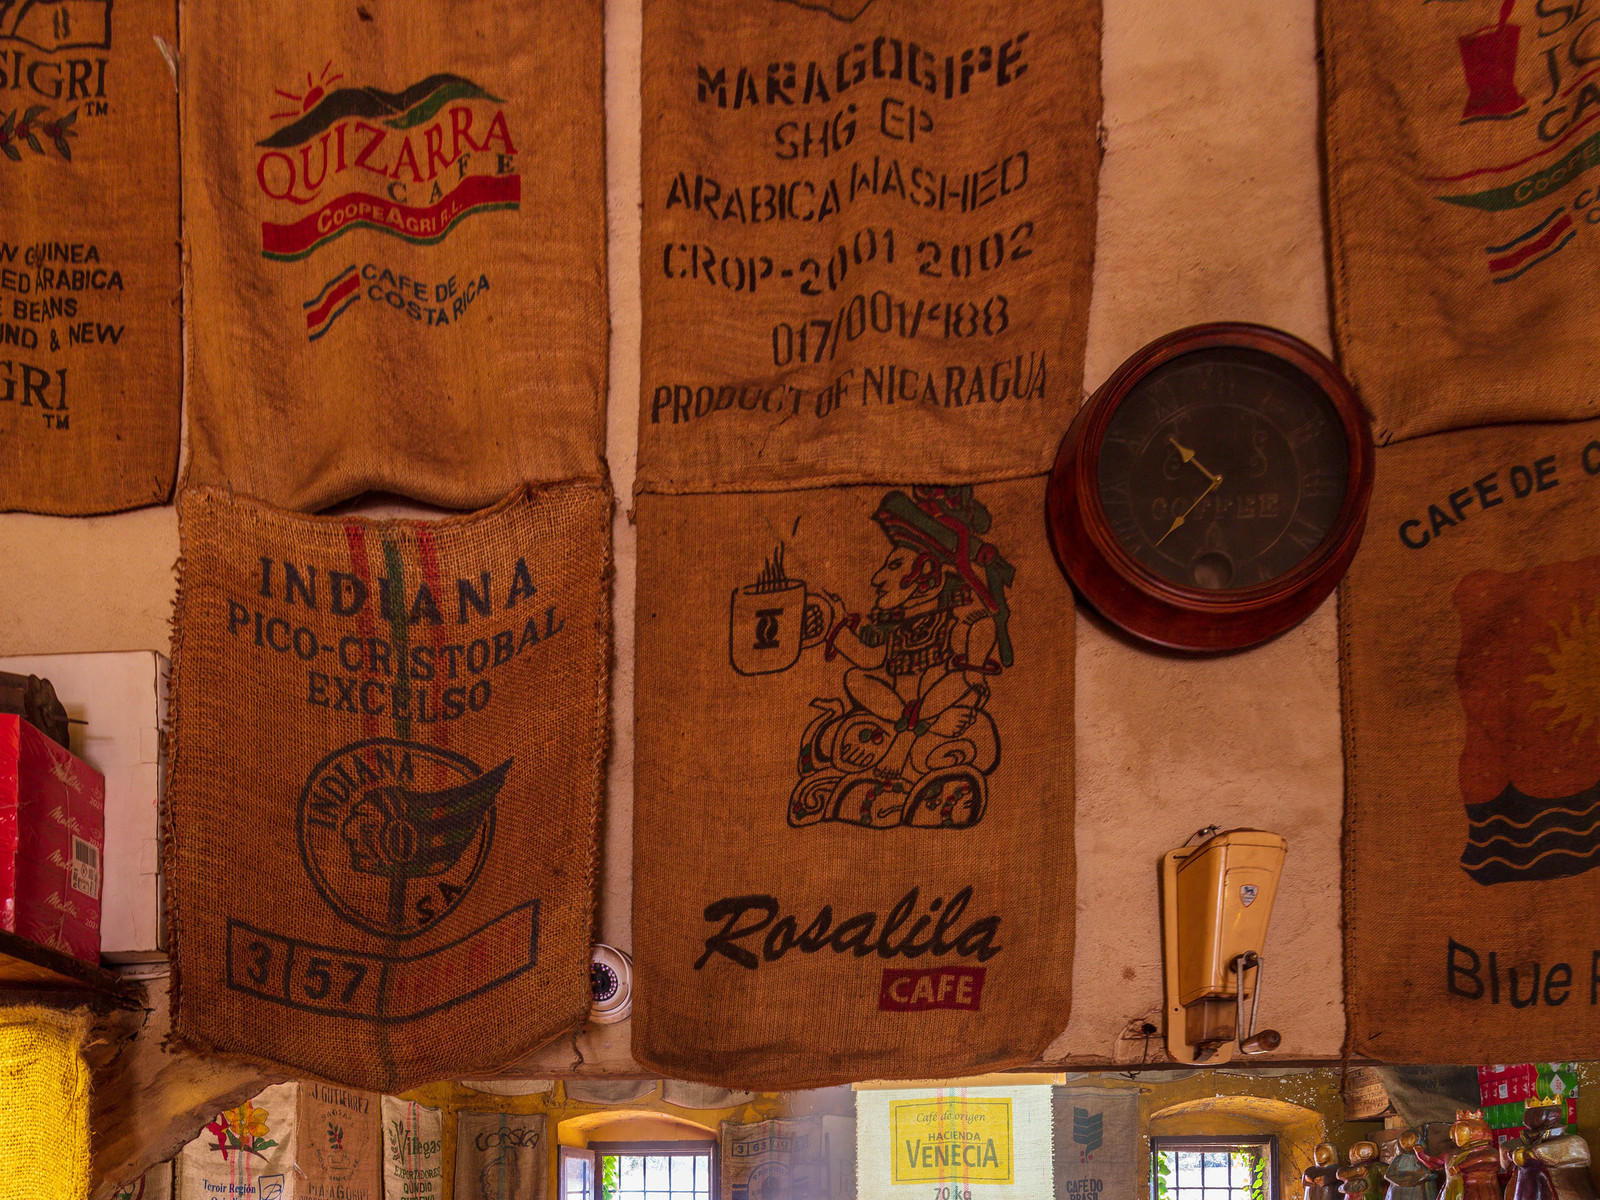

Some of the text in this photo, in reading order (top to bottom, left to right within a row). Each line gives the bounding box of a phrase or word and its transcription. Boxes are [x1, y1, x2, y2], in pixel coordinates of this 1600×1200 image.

[697, 31, 1030, 110] MARAGOGIPE
[775, 98, 934, 160] SHG EP
[256, 106, 518, 206] QUIZARRA
[387, 152, 515, 205] CAFE
[665, 150, 1030, 224] ARABICA WASHED
[25, 242, 100, 266] GUINEA
[917, 221, 1034, 279] 2002
[35, 268, 124, 295] ARABICA
[361, 263, 458, 303] CAFE DE
[367, 274, 490, 327] COSTA RICA
[13, 297, 78, 323] BEANS
[0, 322, 125, 353] ND & NEW
[651, 351, 1048, 425] PRODUCT OF NICARAGUA
[1398, 471, 1504, 549] CAFE
[1510, 454, 1560, 499] DE
[258, 556, 537, 626] INDIANA
[306, 670, 492, 724] EXCELSO
[306, 748, 415, 831] INDIANA
[694, 886, 1003, 970] Rosalila
[246, 939, 369, 1001] 3 57
[886, 974, 975, 1006] CAFE
[1447, 936, 1573, 1009] Blue
[916, 1112, 937, 1125] Café
[955, 1113, 986, 1125] origen
[928, 1131, 981, 1141] HACIENDA
[906, 1138, 999, 1168] VENECIA
[934, 1187, 950, 1200] 70
[1066, 1176, 1103, 1193] CAFÉ DO
